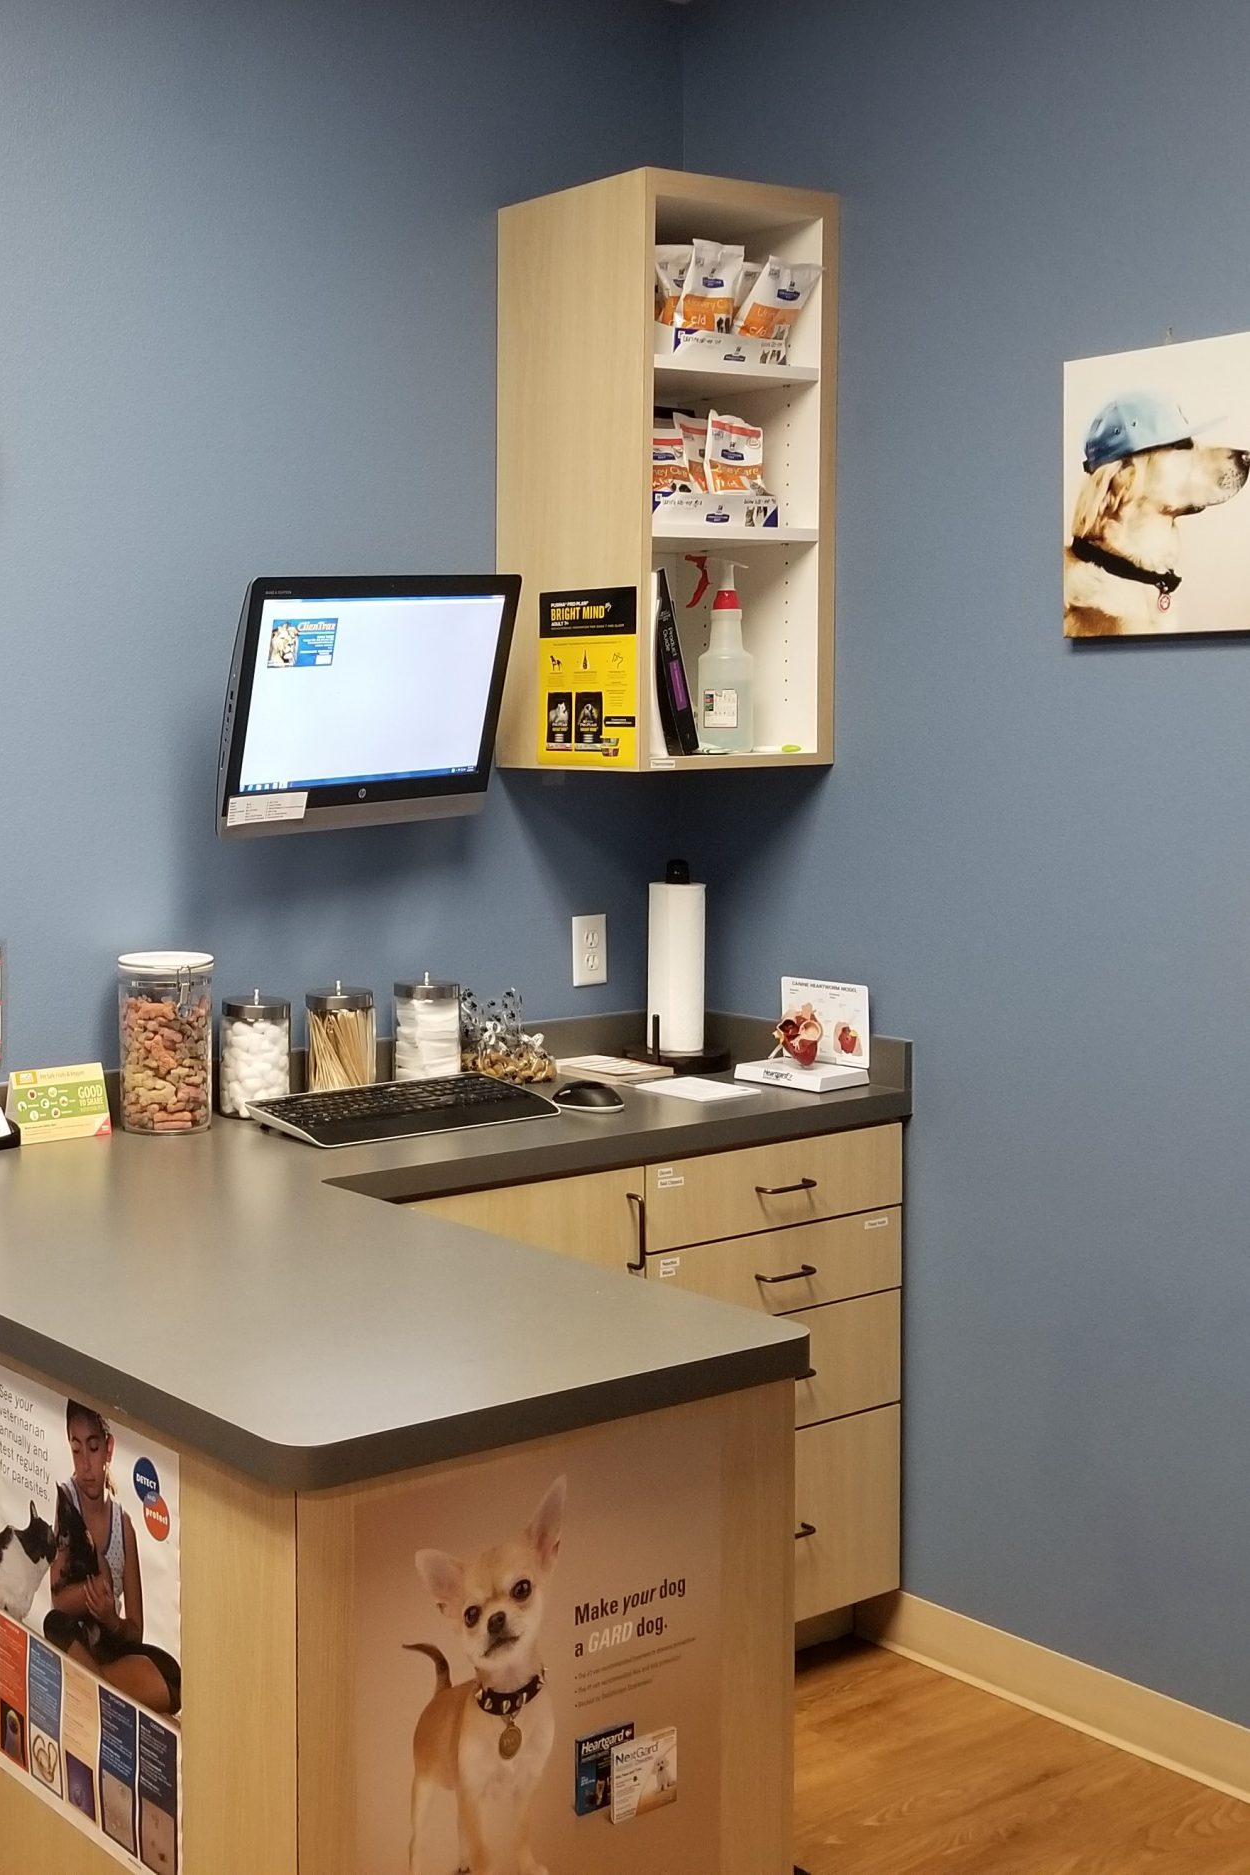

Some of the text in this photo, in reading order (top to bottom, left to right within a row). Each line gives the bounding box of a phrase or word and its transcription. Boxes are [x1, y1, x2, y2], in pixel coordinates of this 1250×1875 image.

[551, 605, 605, 622] BRIGHT MIND
[78, 1084, 102, 1098] GOOD
[0, 1384, 34, 1412] See your
[0, 1406, 45, 1440] veterinarian
[0, 1424, 48, 1461] annually and
[0, 1442, 50, 1484] test regularly
[0, 1459, 50, 1502] for parasites.
[136, 1473, 156, 1489] DETECT
[146, 1509, 168, 1525] protect
[574, 1578, 686, 1626] Make your dog
[574, 1616, 668, 1658] a GARD dog.
[581, 1730, 624, 1755] Heartgard
[615, 1740, 659, 1766] NexGard
